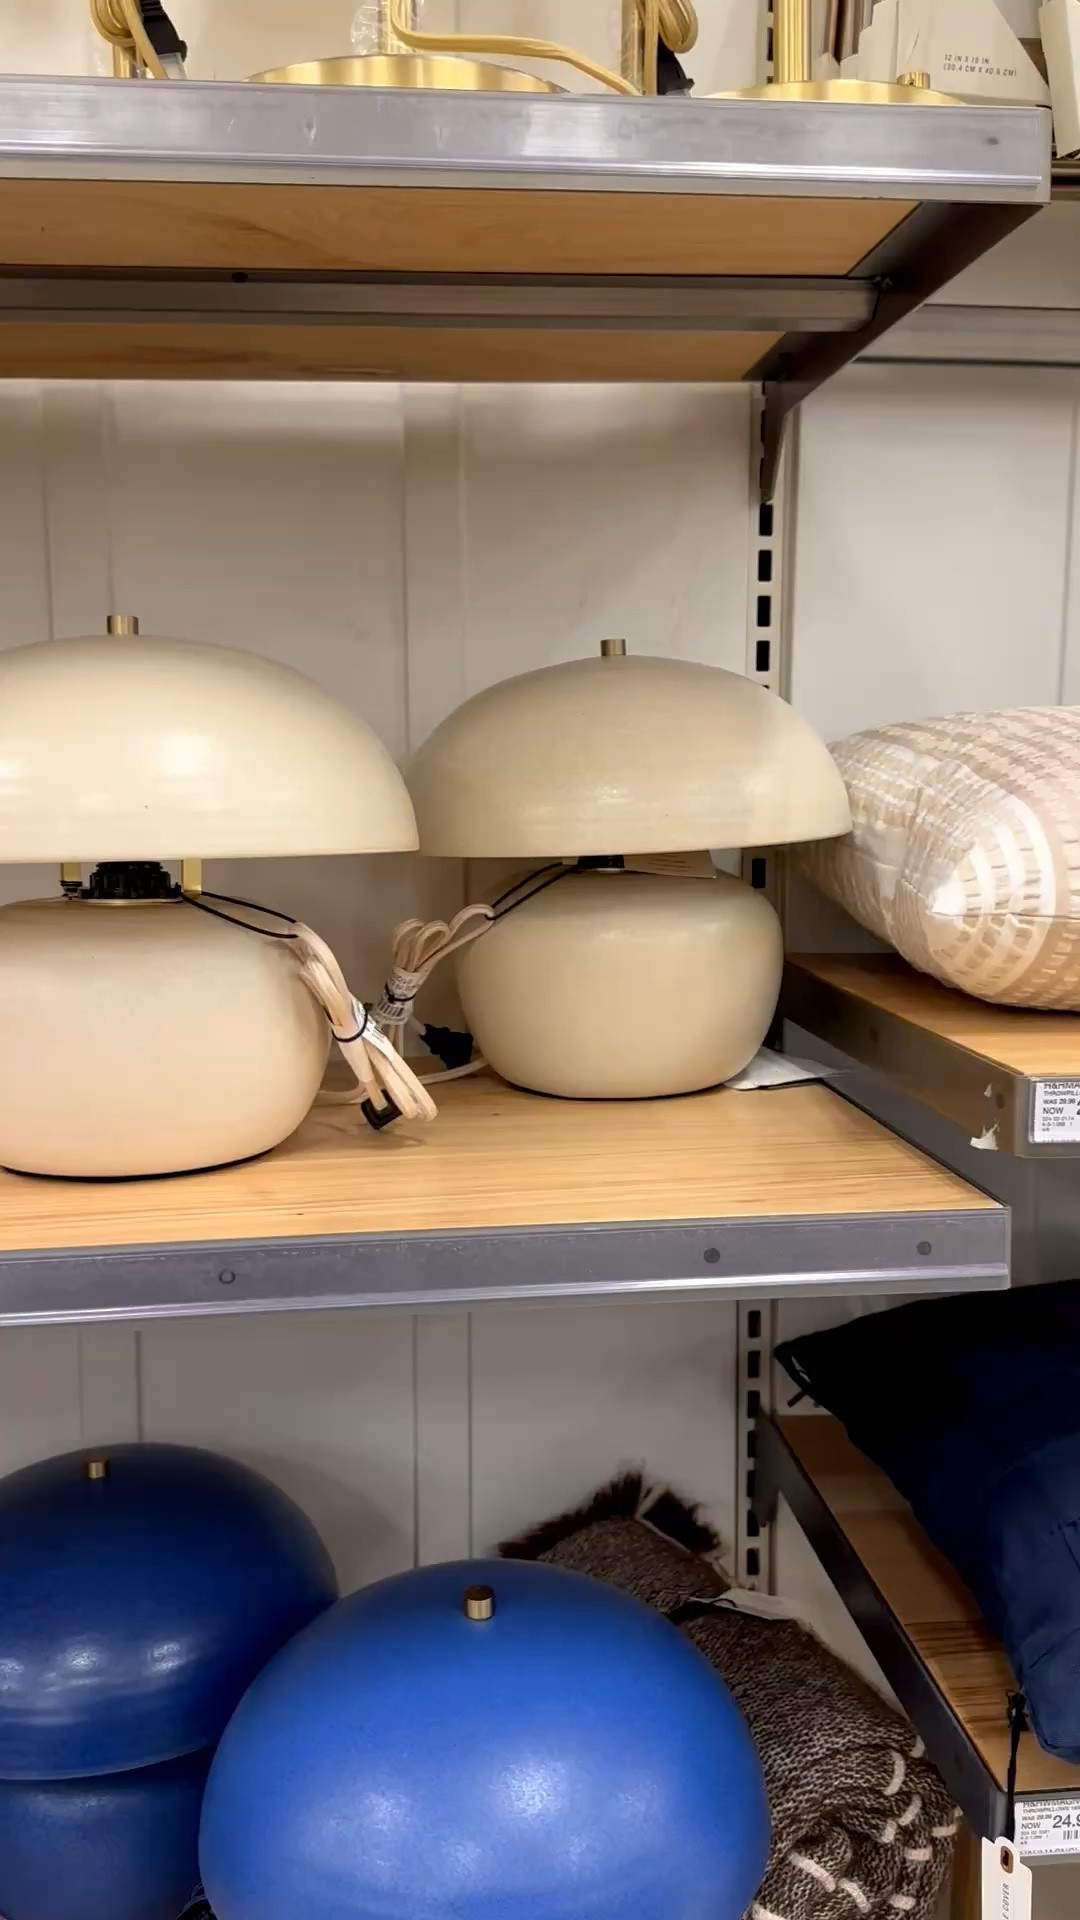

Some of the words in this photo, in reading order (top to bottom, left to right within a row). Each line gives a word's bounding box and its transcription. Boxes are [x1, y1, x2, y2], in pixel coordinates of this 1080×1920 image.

[964, 55, 969, 63] X
[1003, 68, 1017, 77] CM)
[1042, 1106, 1064, 1115] NOW
[1002, 1882, 1010, 1912] COVER
